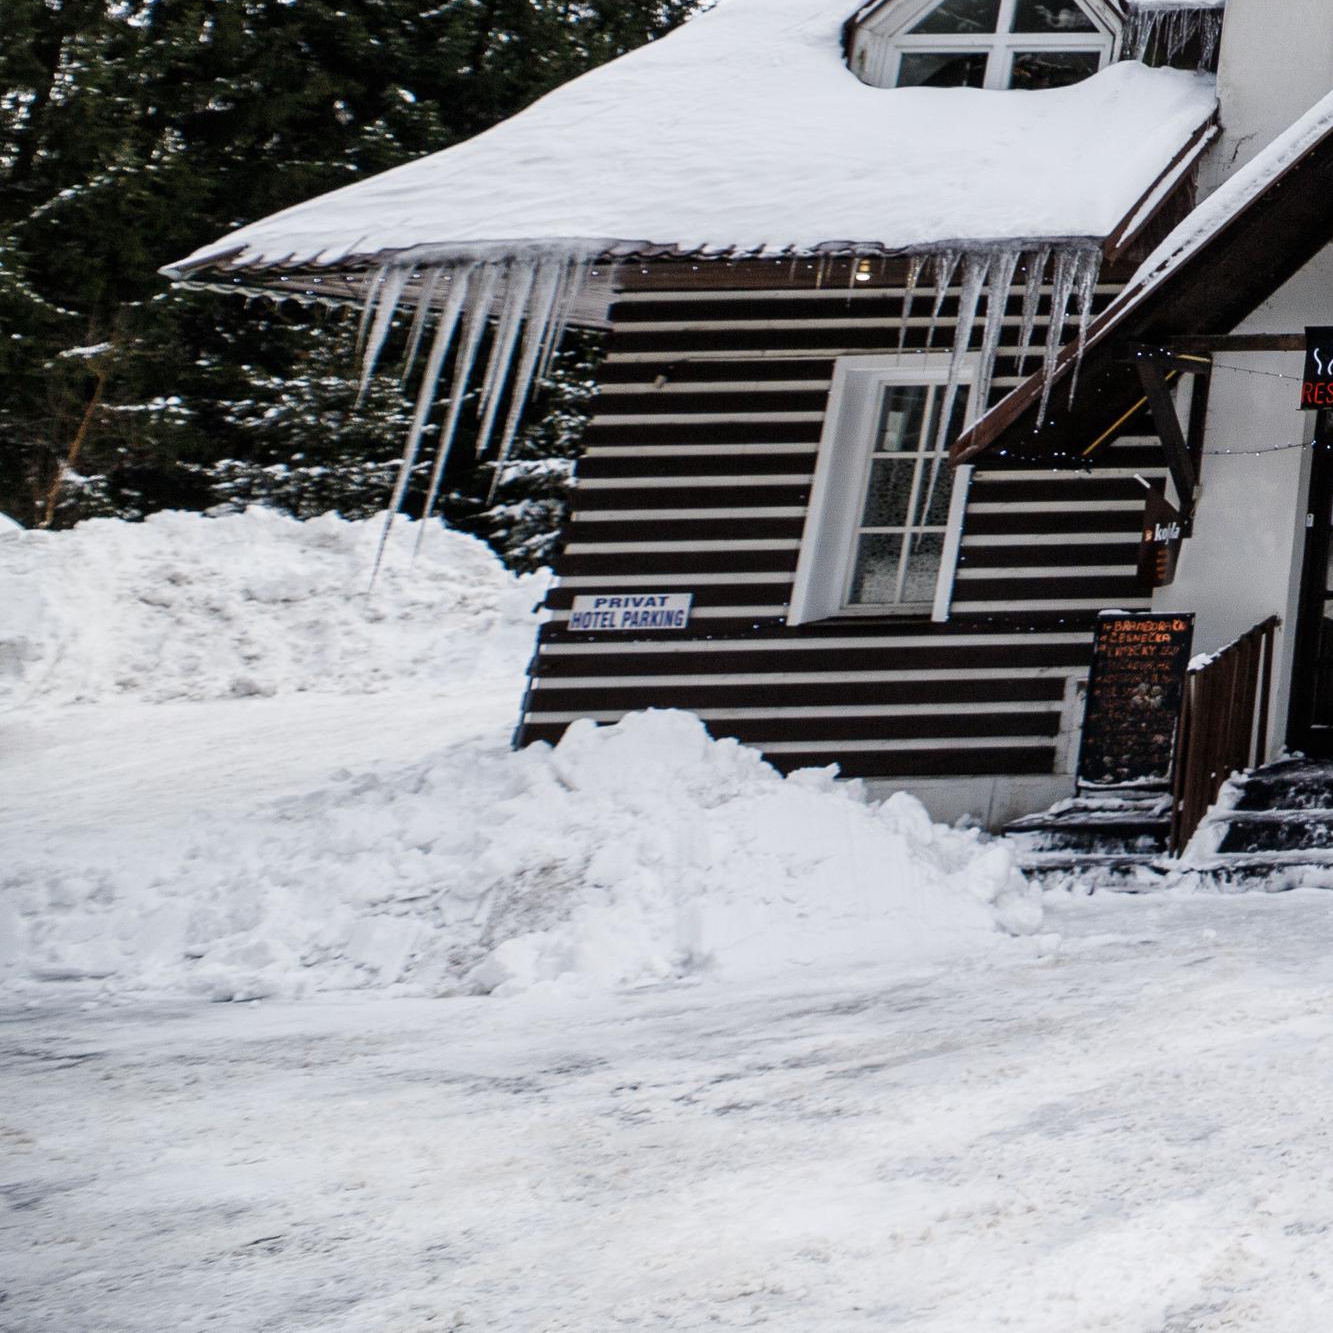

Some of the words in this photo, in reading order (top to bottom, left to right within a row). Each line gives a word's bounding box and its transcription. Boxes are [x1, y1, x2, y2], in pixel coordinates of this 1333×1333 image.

[594, 596, 669, 609] PRIVAT
[572, 610, 617, 628] HOTEL
[621, 609, 685, 628] PARKING
